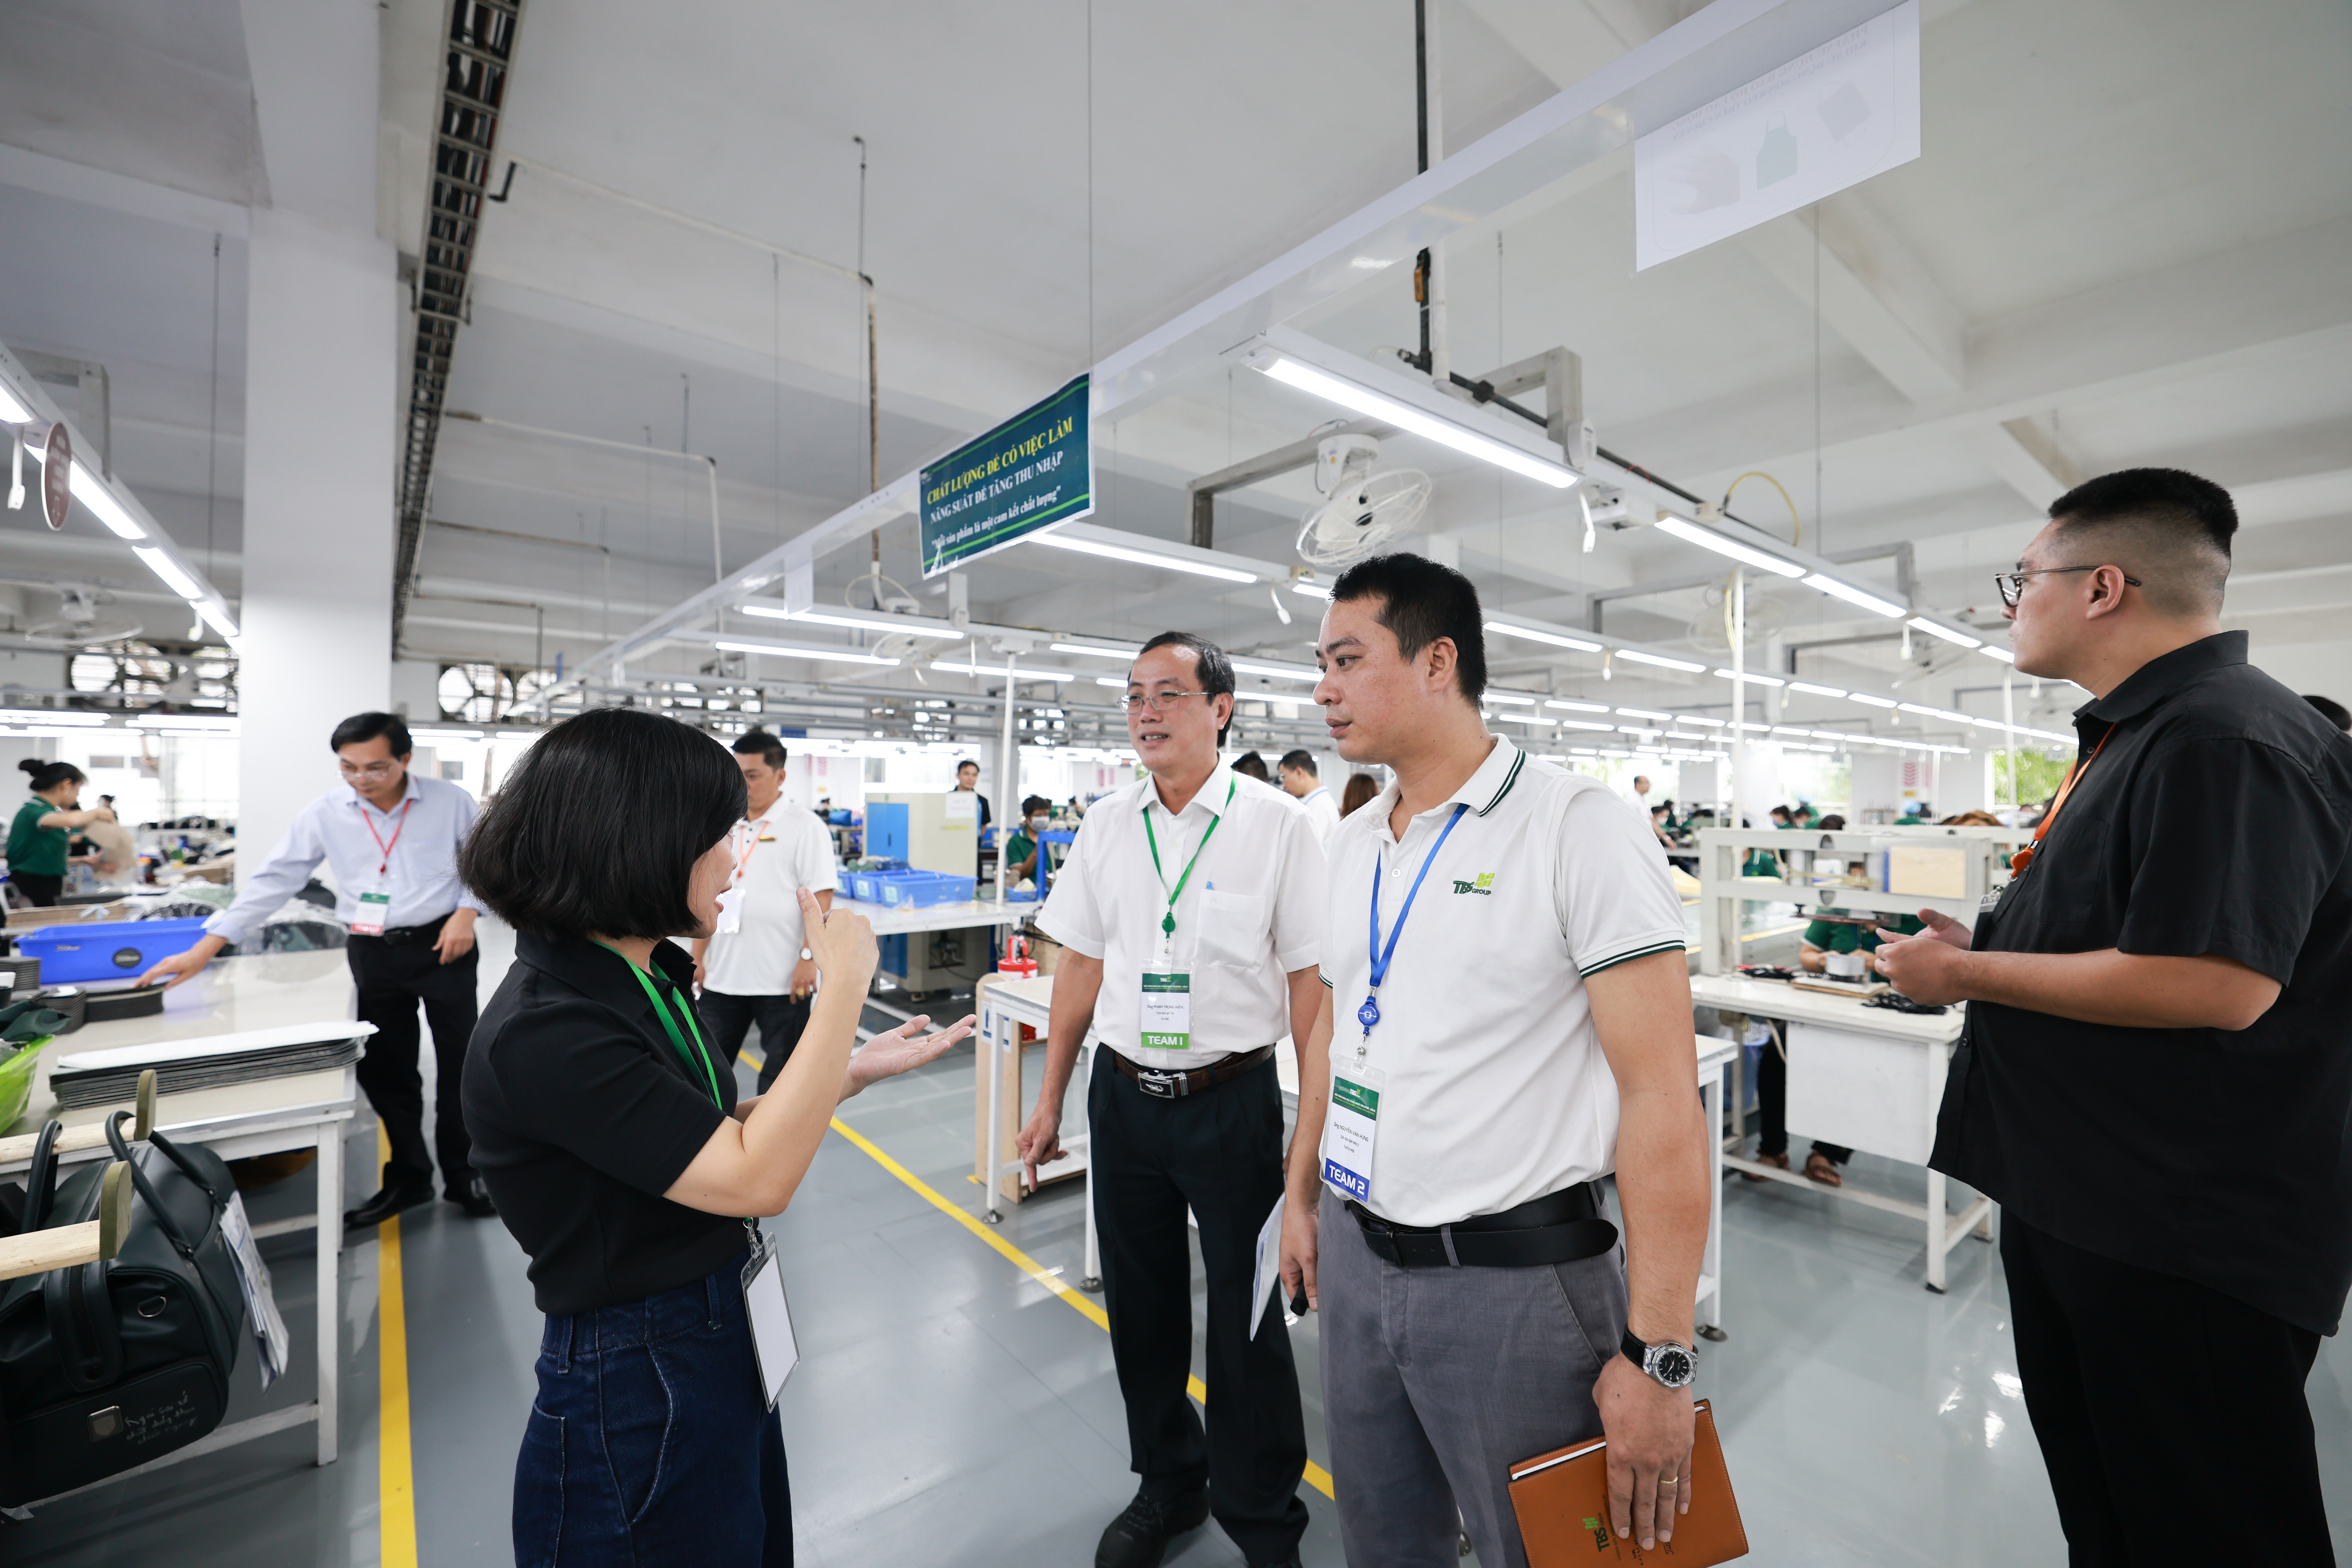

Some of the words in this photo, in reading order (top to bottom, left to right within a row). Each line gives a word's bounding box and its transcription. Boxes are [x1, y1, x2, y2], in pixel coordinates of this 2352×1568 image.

[927, 481, 950, 505] CHẤT
[951, 464, 985, 492] LƯỢNG
[1002, 444, 1018, 468] CÓ
[1019, 432, 1046, 458] VIỆC
[1048, 416, 1073, 445] LÀM
[930, 505, 952, 524] NĂNG
[952, 492, 974, 515] SUẤT
[988, 476, 1013, 499] TĂNG
[1014, 465, 1035, 486] THU
[1036, 450, 1063, 476] NHẬP
[974, 521, 981, 534] là
[981, 515, 994, 531] một
[994, 511, 1008, 526] cam
[1008, 502, 1020, 519] kết
[1020, 495, 1036, 514] chất
[1453, 880, 1475, 894] TBS
[1147, 1035, 1177, 1045] TEAM
[1339, 1125, 1352, 1134] NGUYỄN
[1329, 1165, 1355, 1191] TEAM
[1357, 1181, 1365, 1195] 2
[1594, 1527, 1610, 1552] TBS
